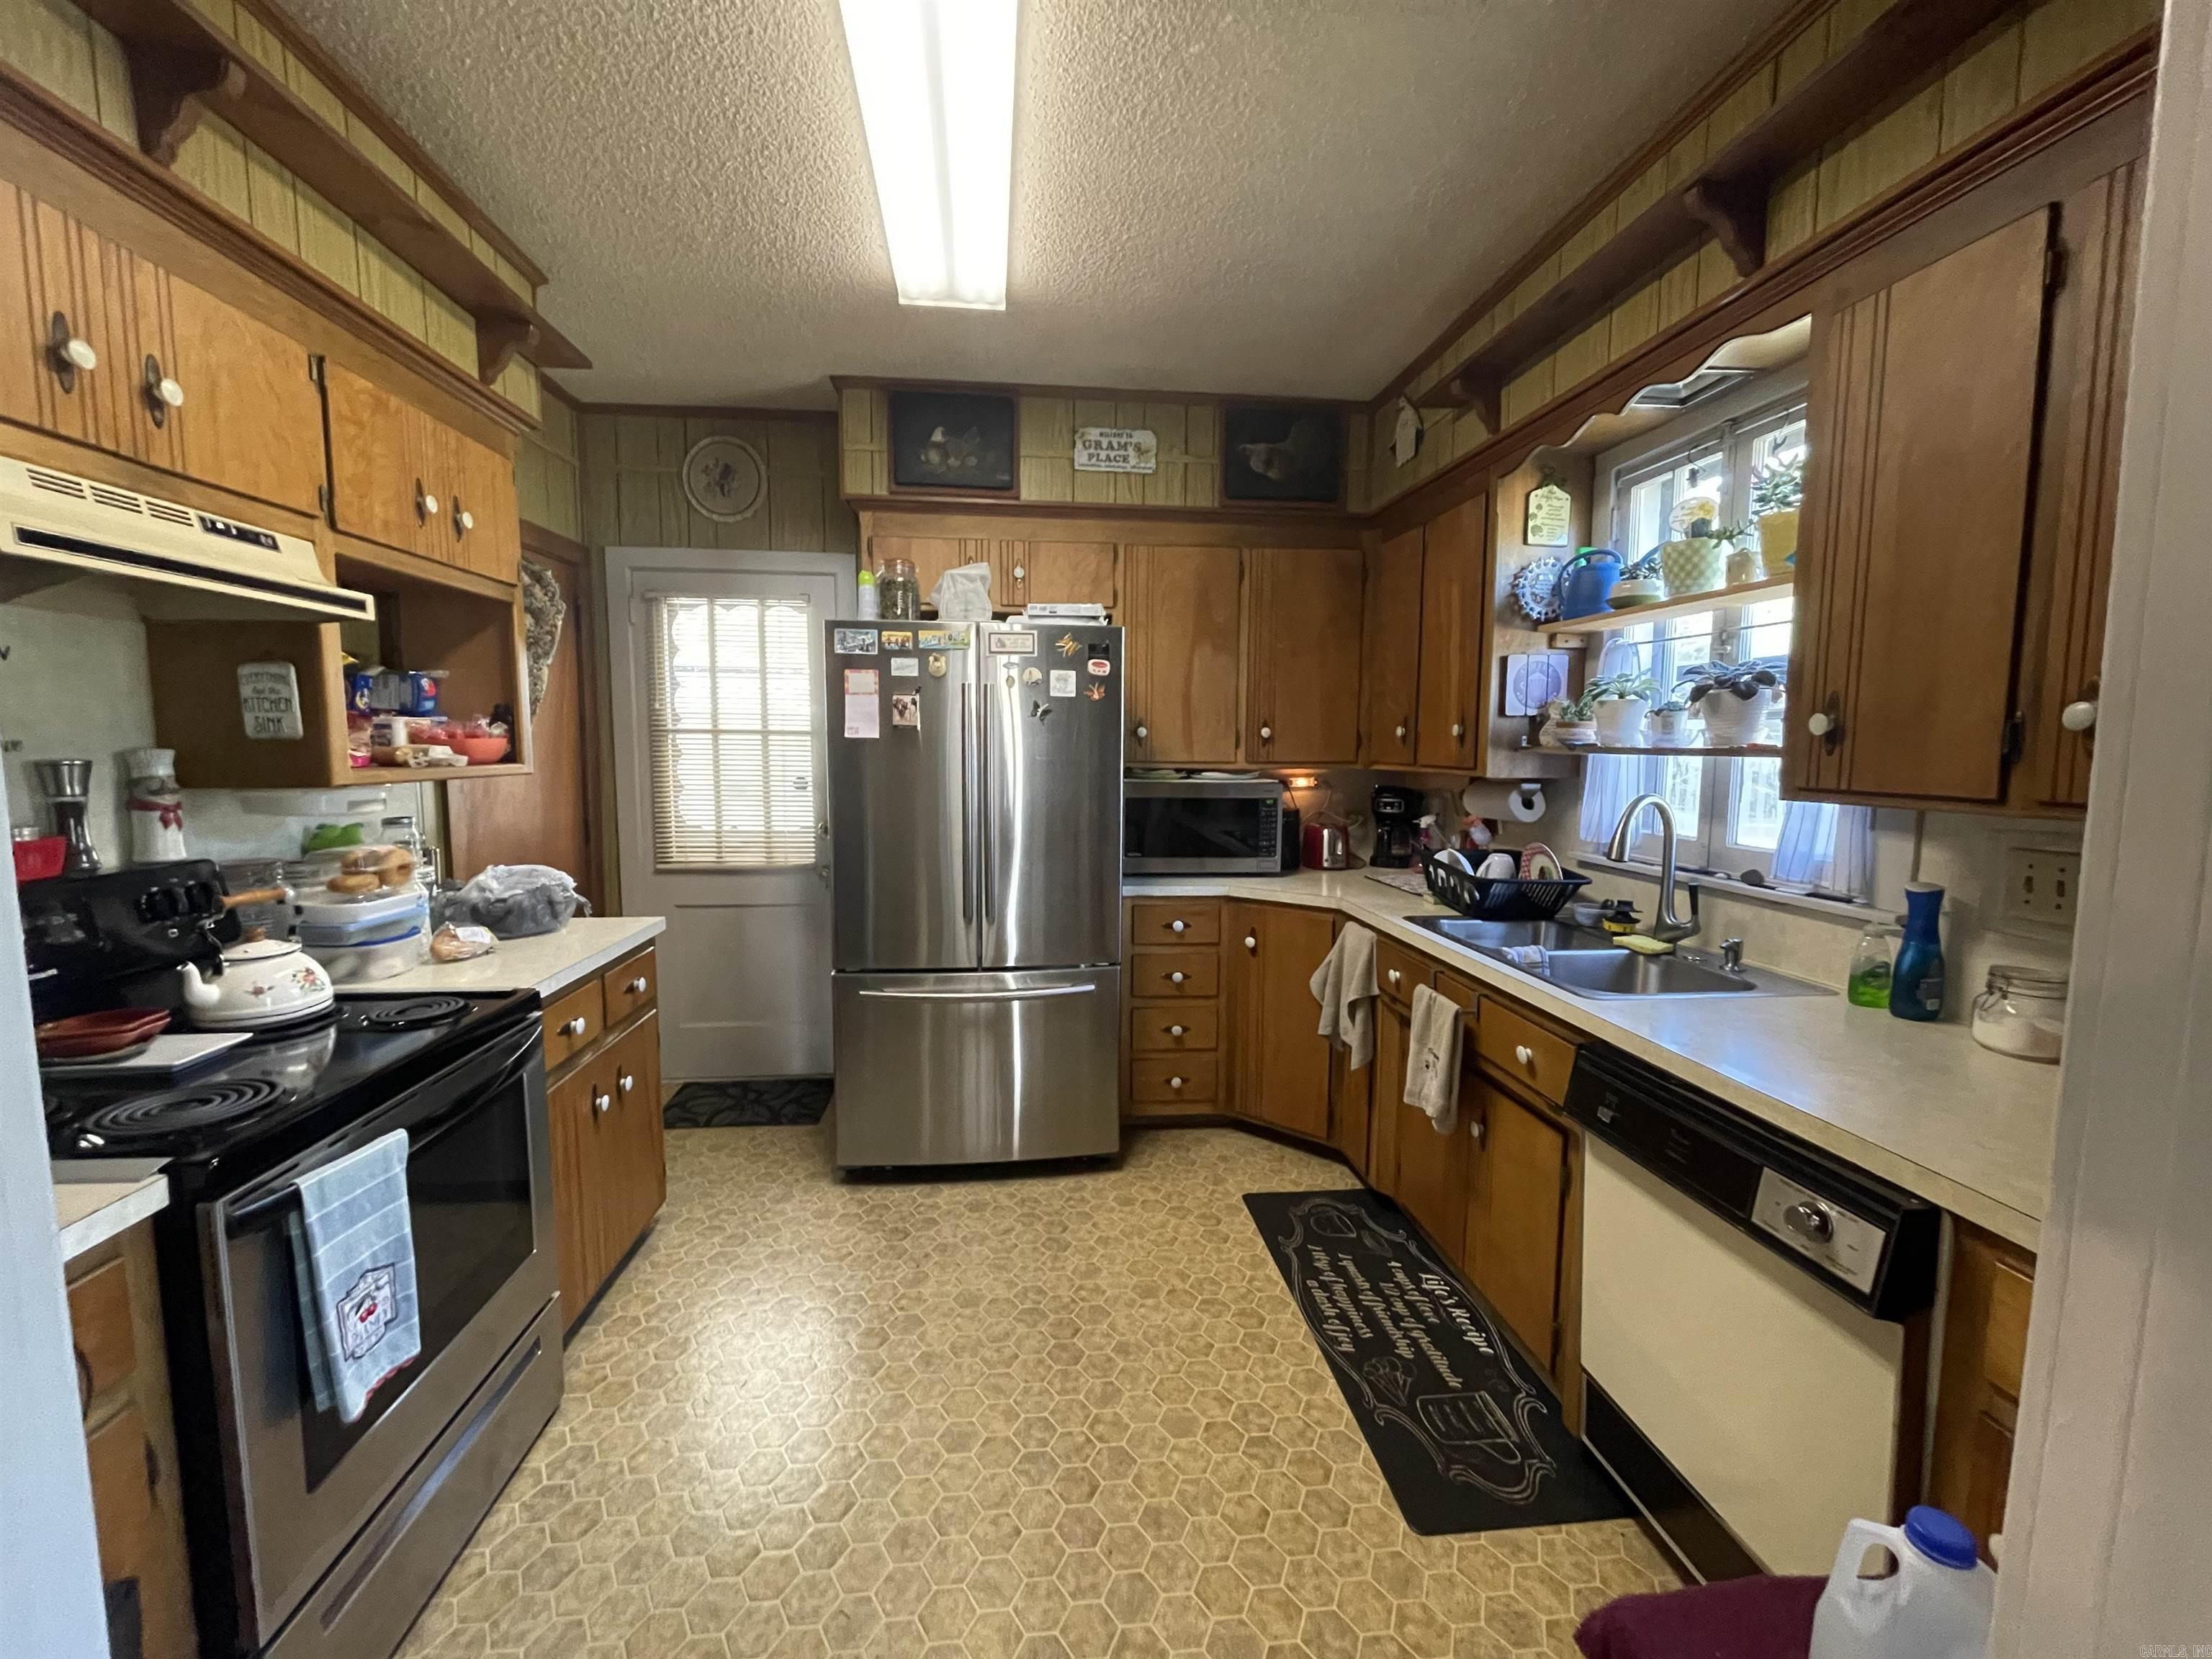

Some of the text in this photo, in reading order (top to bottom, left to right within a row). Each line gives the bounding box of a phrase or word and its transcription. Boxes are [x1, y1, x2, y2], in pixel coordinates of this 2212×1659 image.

[1082, 439, 1142, 452] GRAM'S
[1087, 452, 1130, 464] PLACE
[1310, 1288, 1340, 1316] dash
[1326, 1328, 1355, 1352] joy
[1331, 1282, 1373, 1338] happiness
[1391, 1268, 1416, 1290] cups
[1416, 1302, 1439, 1323] love
[1418, 1272, 1458, 1304] Life's
[1447, 1307, 1494, 1354] Recipe
[1363, 1299, 1414, 1358] friendship
[1390, 1297, 1411, 1316] cup
[1408, 1329, 1462, 1388] gratitude
